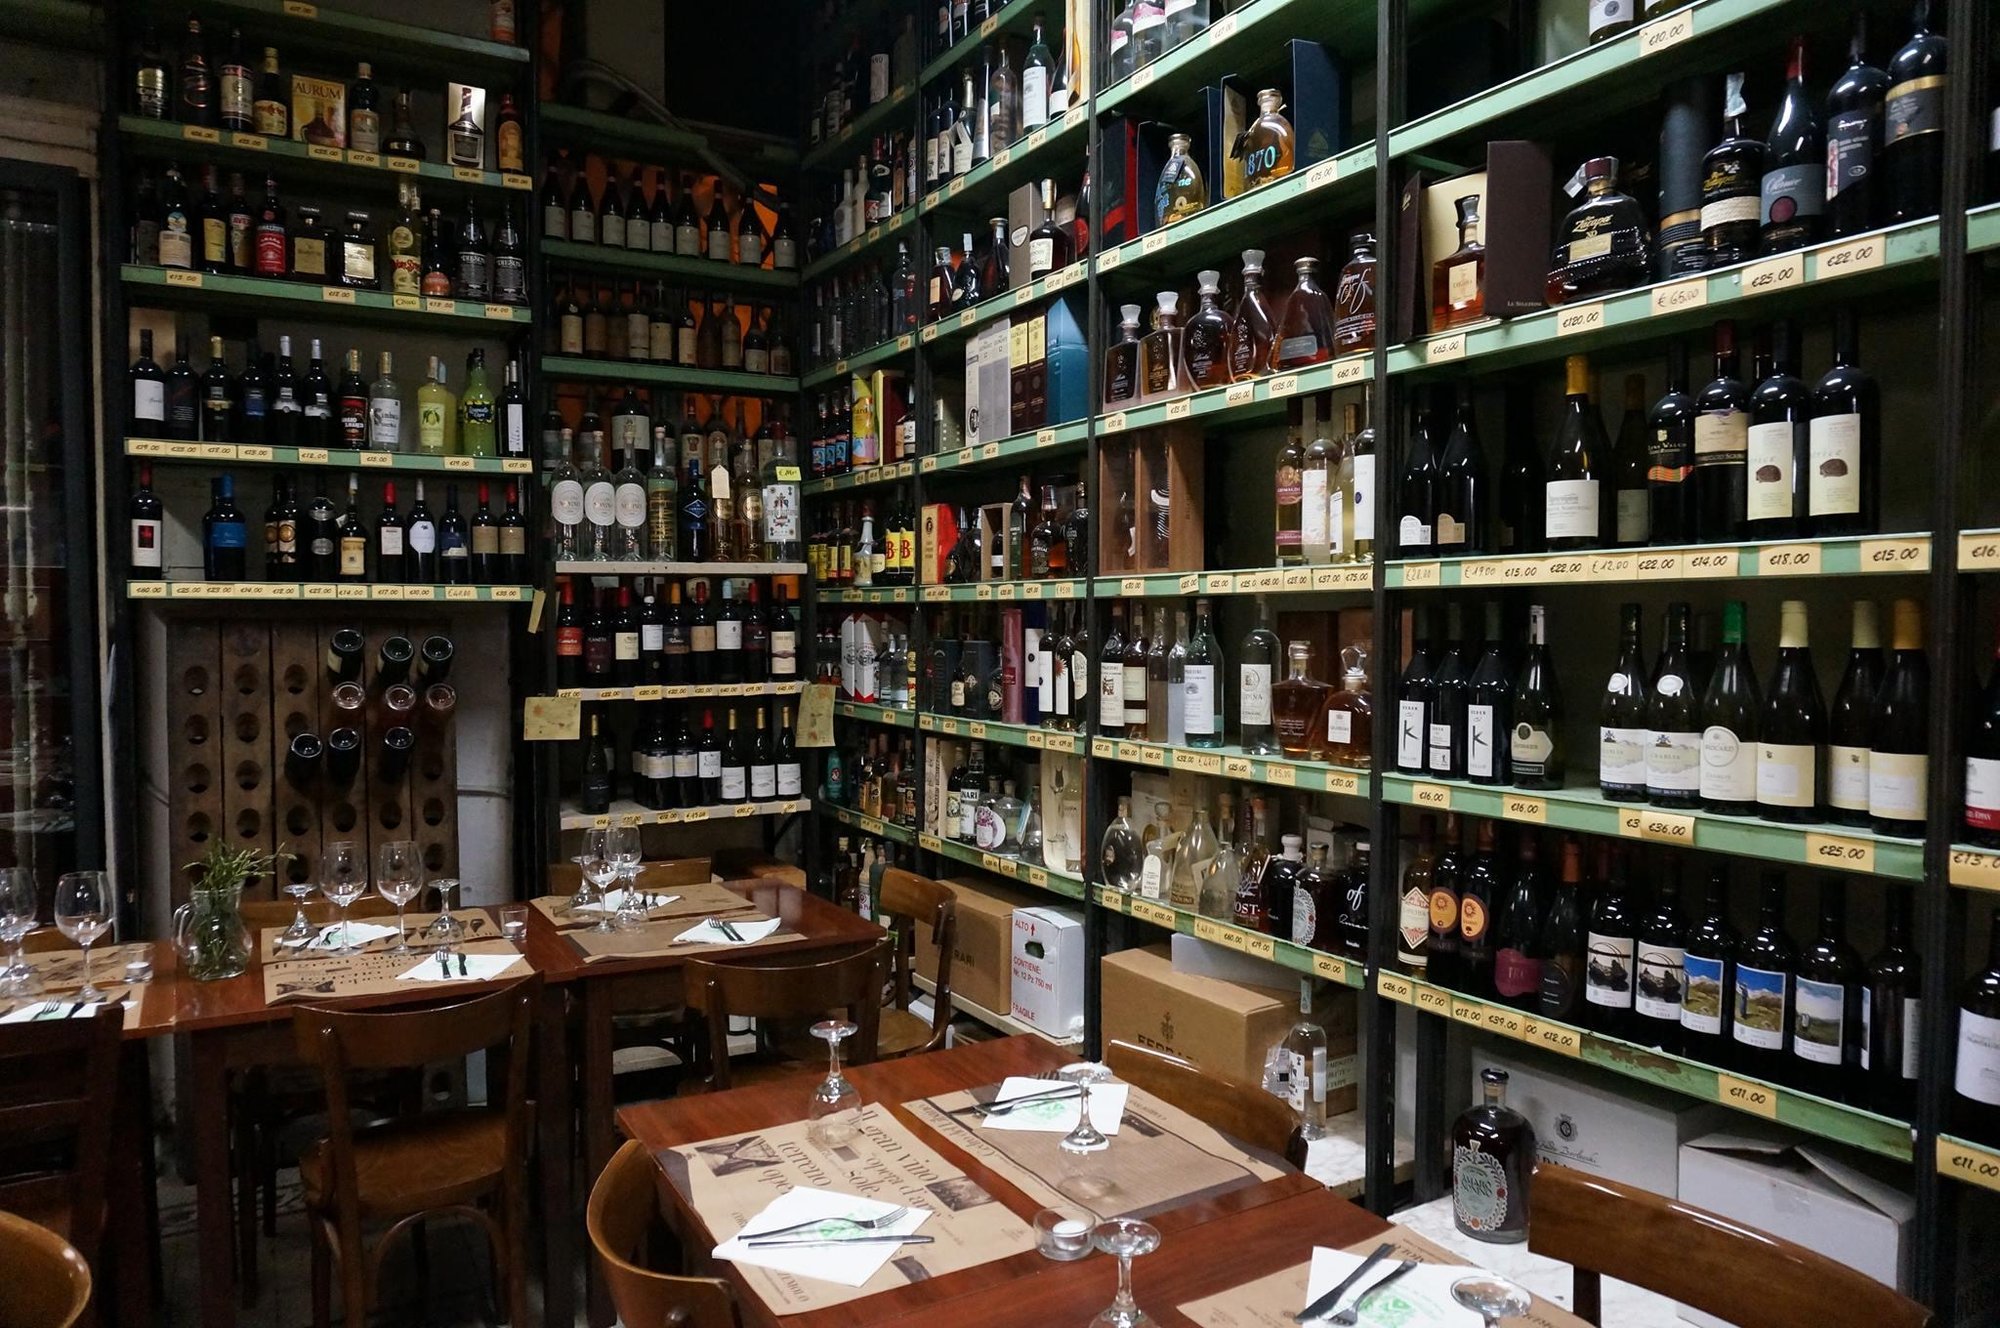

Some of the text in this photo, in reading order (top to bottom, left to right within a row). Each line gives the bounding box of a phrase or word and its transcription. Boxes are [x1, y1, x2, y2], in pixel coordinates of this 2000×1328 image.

[1649, 23, 1685, 46] €10.00
[295, 80, 342, 101] AURUM
[1826, 246, 1874, 267] €22.00
[1751, 267, 1795, 288] €25.00
[1562, 311, 1600, 329] €120.00
[1691, 554, 1728, 568] €14.00
[1769, 552, 1811, 566] €18.00
[1872, 547, 1920, 563] €15.00
[1504, 566, 1538, 578] €15.00
[1550, 562, 1583, 574] €22.00
[1637, 559, 1675, 571] €22.00
[1419, 790, 1445, 803] €16.00
[1511, 802, 1540, 815] €16.00
[1647, 821, 1687, 838] €36.00
[1819, 843, 1866, 860] €25.00
[1015, 919, 1029, 932] ALTO
[1035, 977, 1045, 989] 750
[1383, 981, 1408, 996] €26.00
[1420, 992, 1445, 1008] €17.00
[1012, 1002, 1036, 1021] FRAGILE
[1455, 1007, 1482, 1022] €18.00
[1543, 1030, 1574, 1047] €12.00
[1730, 1086, 1767, 1105] €11.00
[777, 1141, 833, 1187] terreno
[897, 1152, 939, 1183] vino
[1952, 1154, 2000, 1178] €11.00
